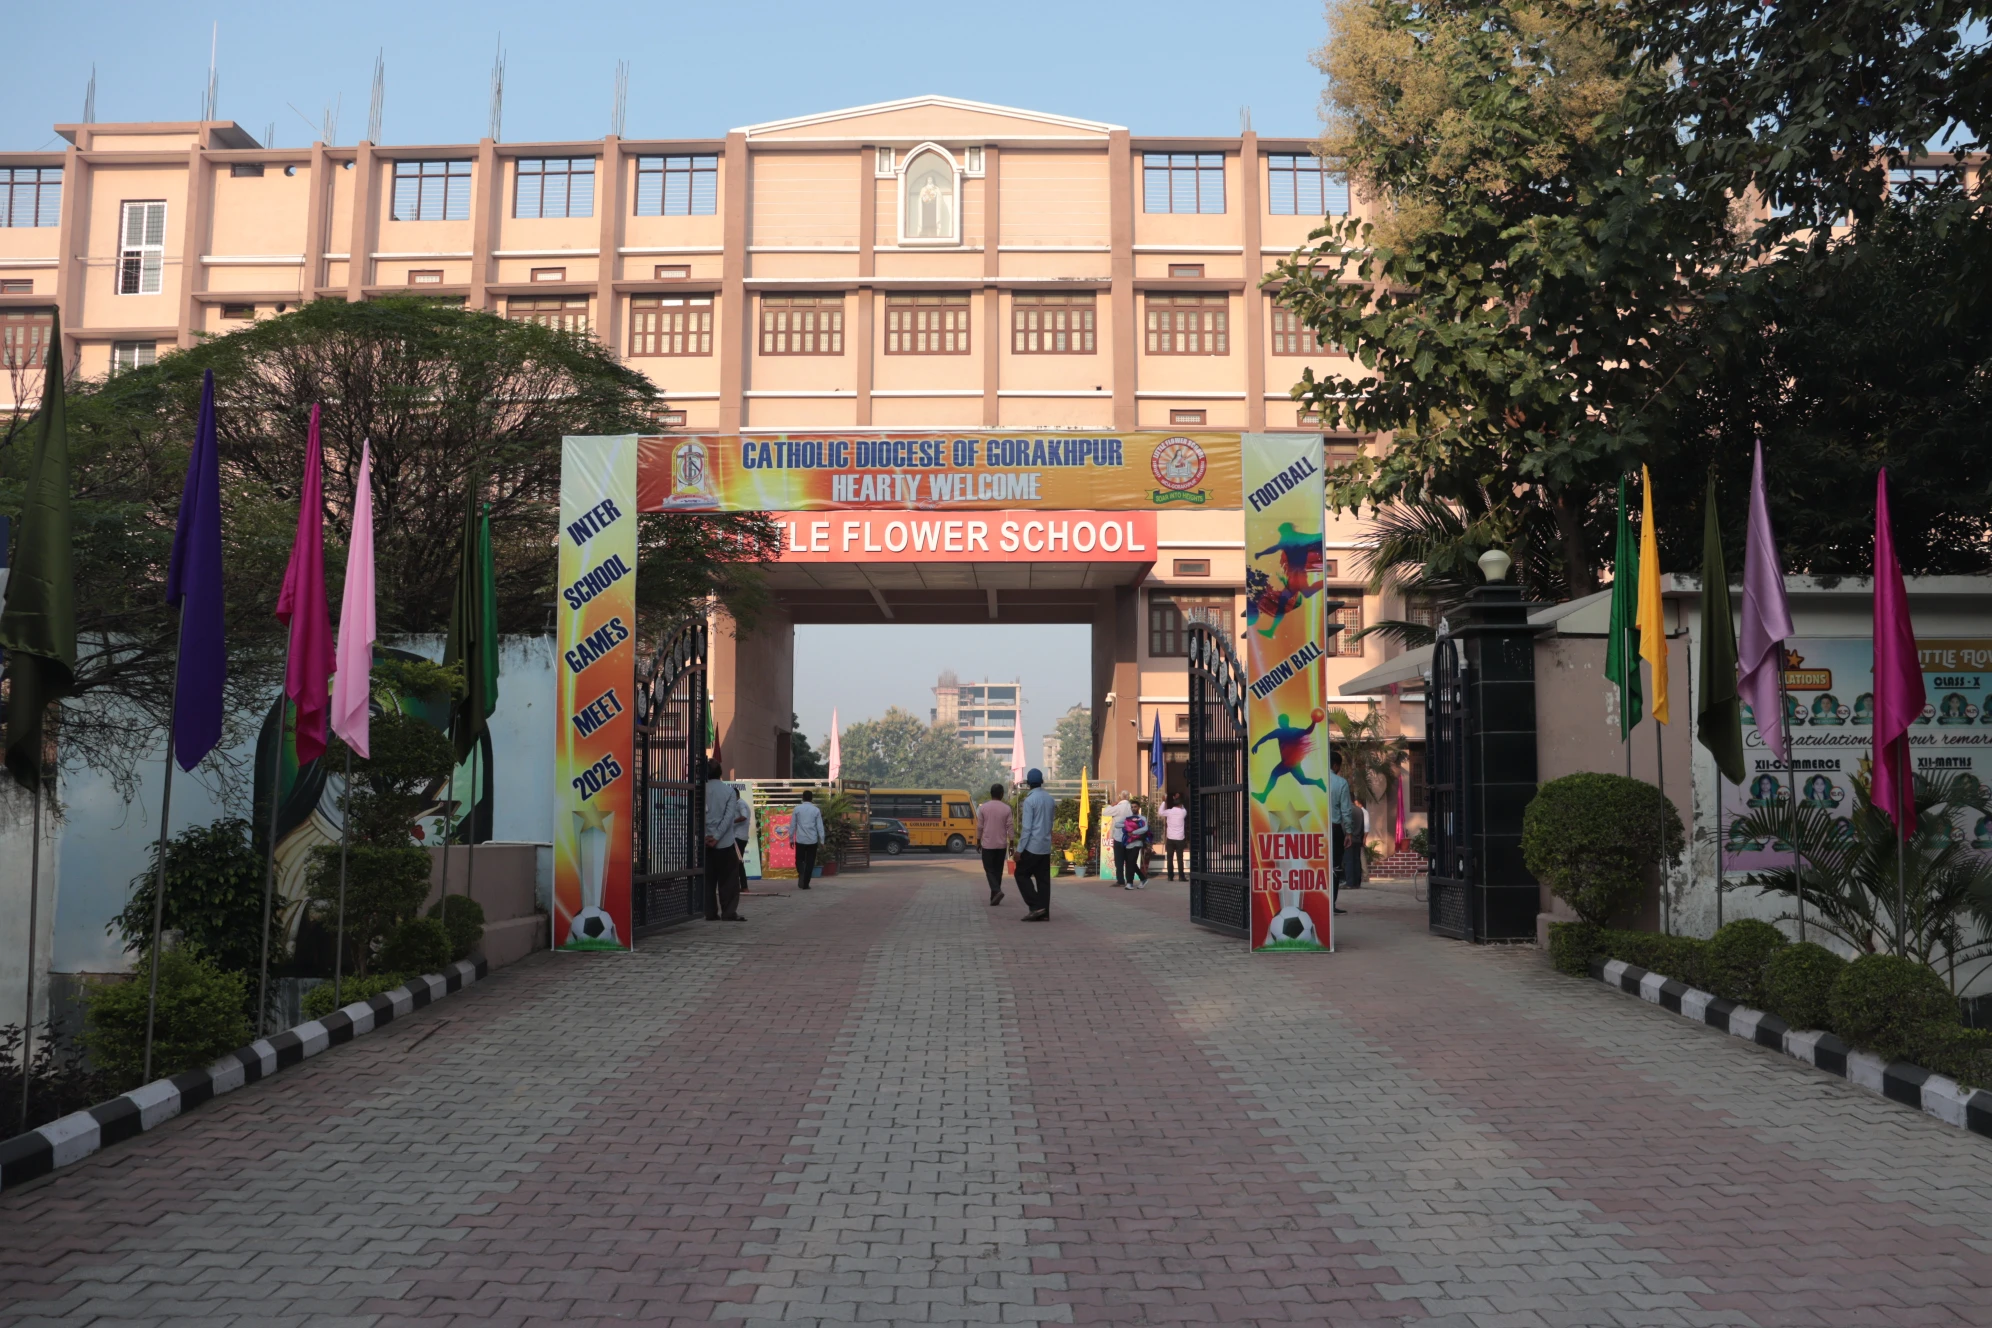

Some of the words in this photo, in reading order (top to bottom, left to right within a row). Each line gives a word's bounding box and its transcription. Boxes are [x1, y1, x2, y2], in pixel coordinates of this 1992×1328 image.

[742, 440, 849, 469] CATHOLIC
[856, 440, 946, 469] DIOCESE
[952, 439, 980, 467] OF
[987, 438, 1123, 467] GORAKHPUR
[832, 473, 922, 502] HEARTY
[929, 472, 1042, 501] WELCOME
[1156, 493, 1169, 502] SOAR
[1182, 492, 1203, 502] HEIGHTS
[1247, 455, 1319, 513] FOOTBALL
[566, 498, 623, 547] INTER
[842, 521, 989, 552] FLOWER
[999, 520, 1145, 552] SCHOOL
[563, 553, 632, 611] SCHOOL
[564, 616, 630, 674] GAMES
[1917, 649, 1957, 668] ITTLE
[1248, 659, 1294, 701] THROW
[1290, 640, 1324, 672] BALL
[1933, 677, 1965, 686] CLASS
[572, 688, 624, 738] MEET
[1908, 734, 1937, 745] our
[572, 753, 623, 802] 2025
[1917, 757, 1972, 767] XII-MATHS
[1258, 833, 1325, 860] VENUE
[1252, 869, 1328, 892] LFS-GIDA
